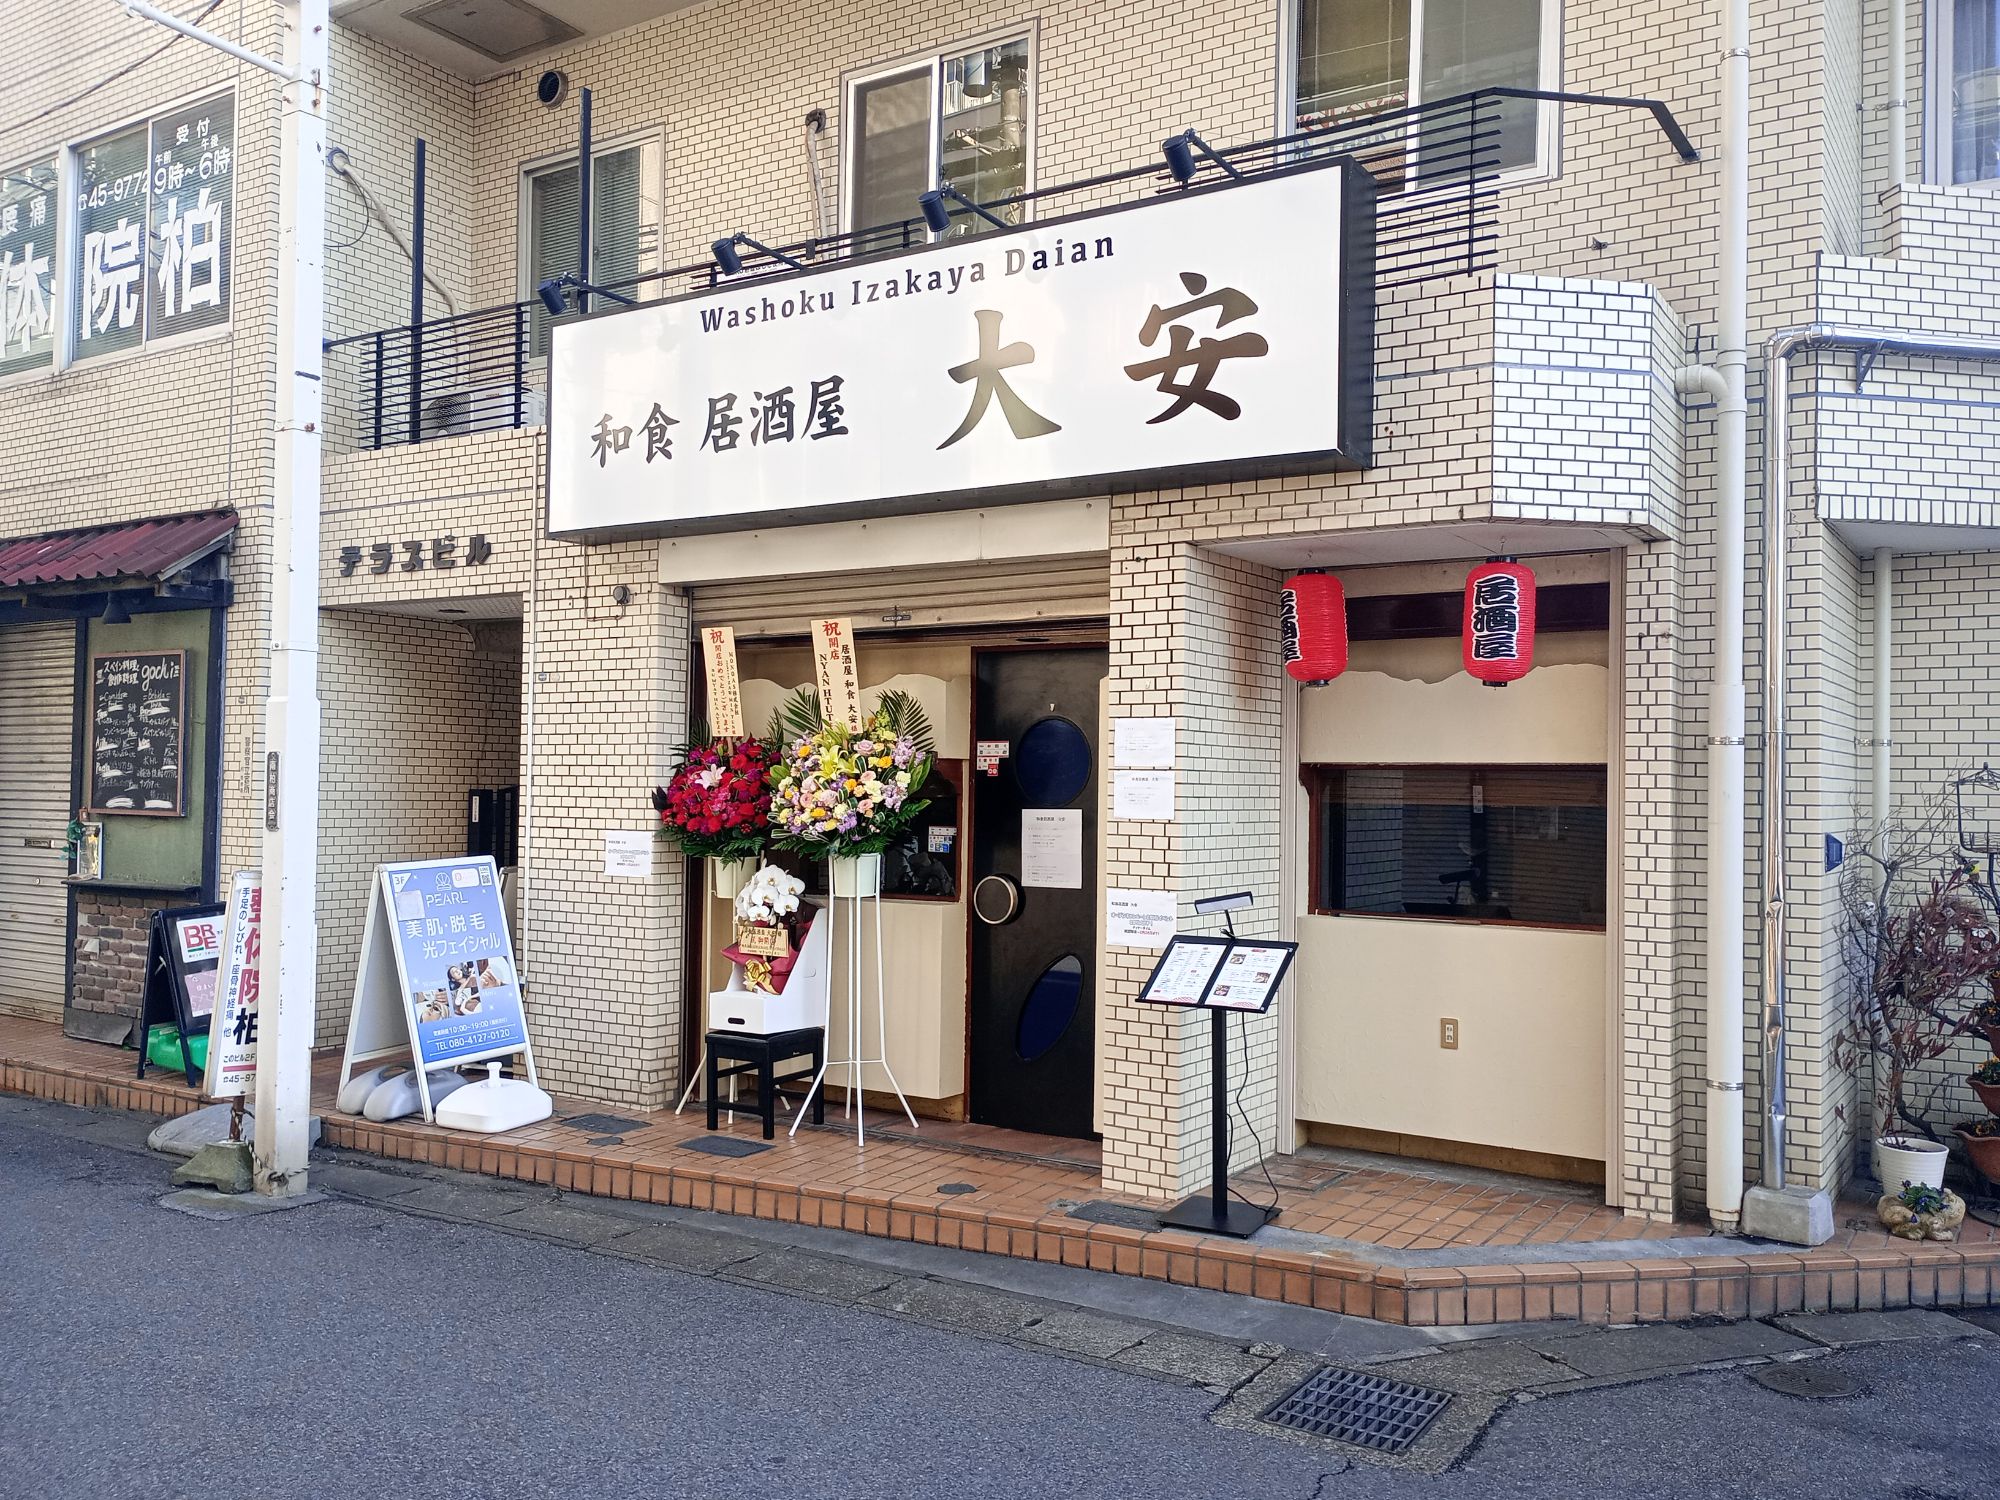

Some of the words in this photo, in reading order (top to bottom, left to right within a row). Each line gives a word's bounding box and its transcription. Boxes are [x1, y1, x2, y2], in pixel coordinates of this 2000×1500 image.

[175, 116, 211, 146] 受付
[699, 290, 836, 334] Washoku
[851, 258, 986, 307] Izakaya
[1005, 234, 1115, 275] Daian
[590, 402, 681, 469] 和食
[700, 375, 849, 453] 居酒屋
[936, 272, 1269, 450] 大安
[339, 534, 492, 577] テラスビル
[1473, 574, 1519, 661] 居酒屋
[819, 653, 831, 687] NYAN
[841, 644, 854, 676] 居酒屋
[823, 689, 833, 722] HTUT
[844, 680, 856, 700] 和食
[394, 876, 406, 885] 3F
[426, 891, 469, 908] PEARL
[406, 913, 486, 940] 美肌・脱毛
[422, 932, 501, 960] 光フェイシャル
[435, 1040, 448, 1051] TEL
[449, 1028, 510, 1049] 080-4127-0120
